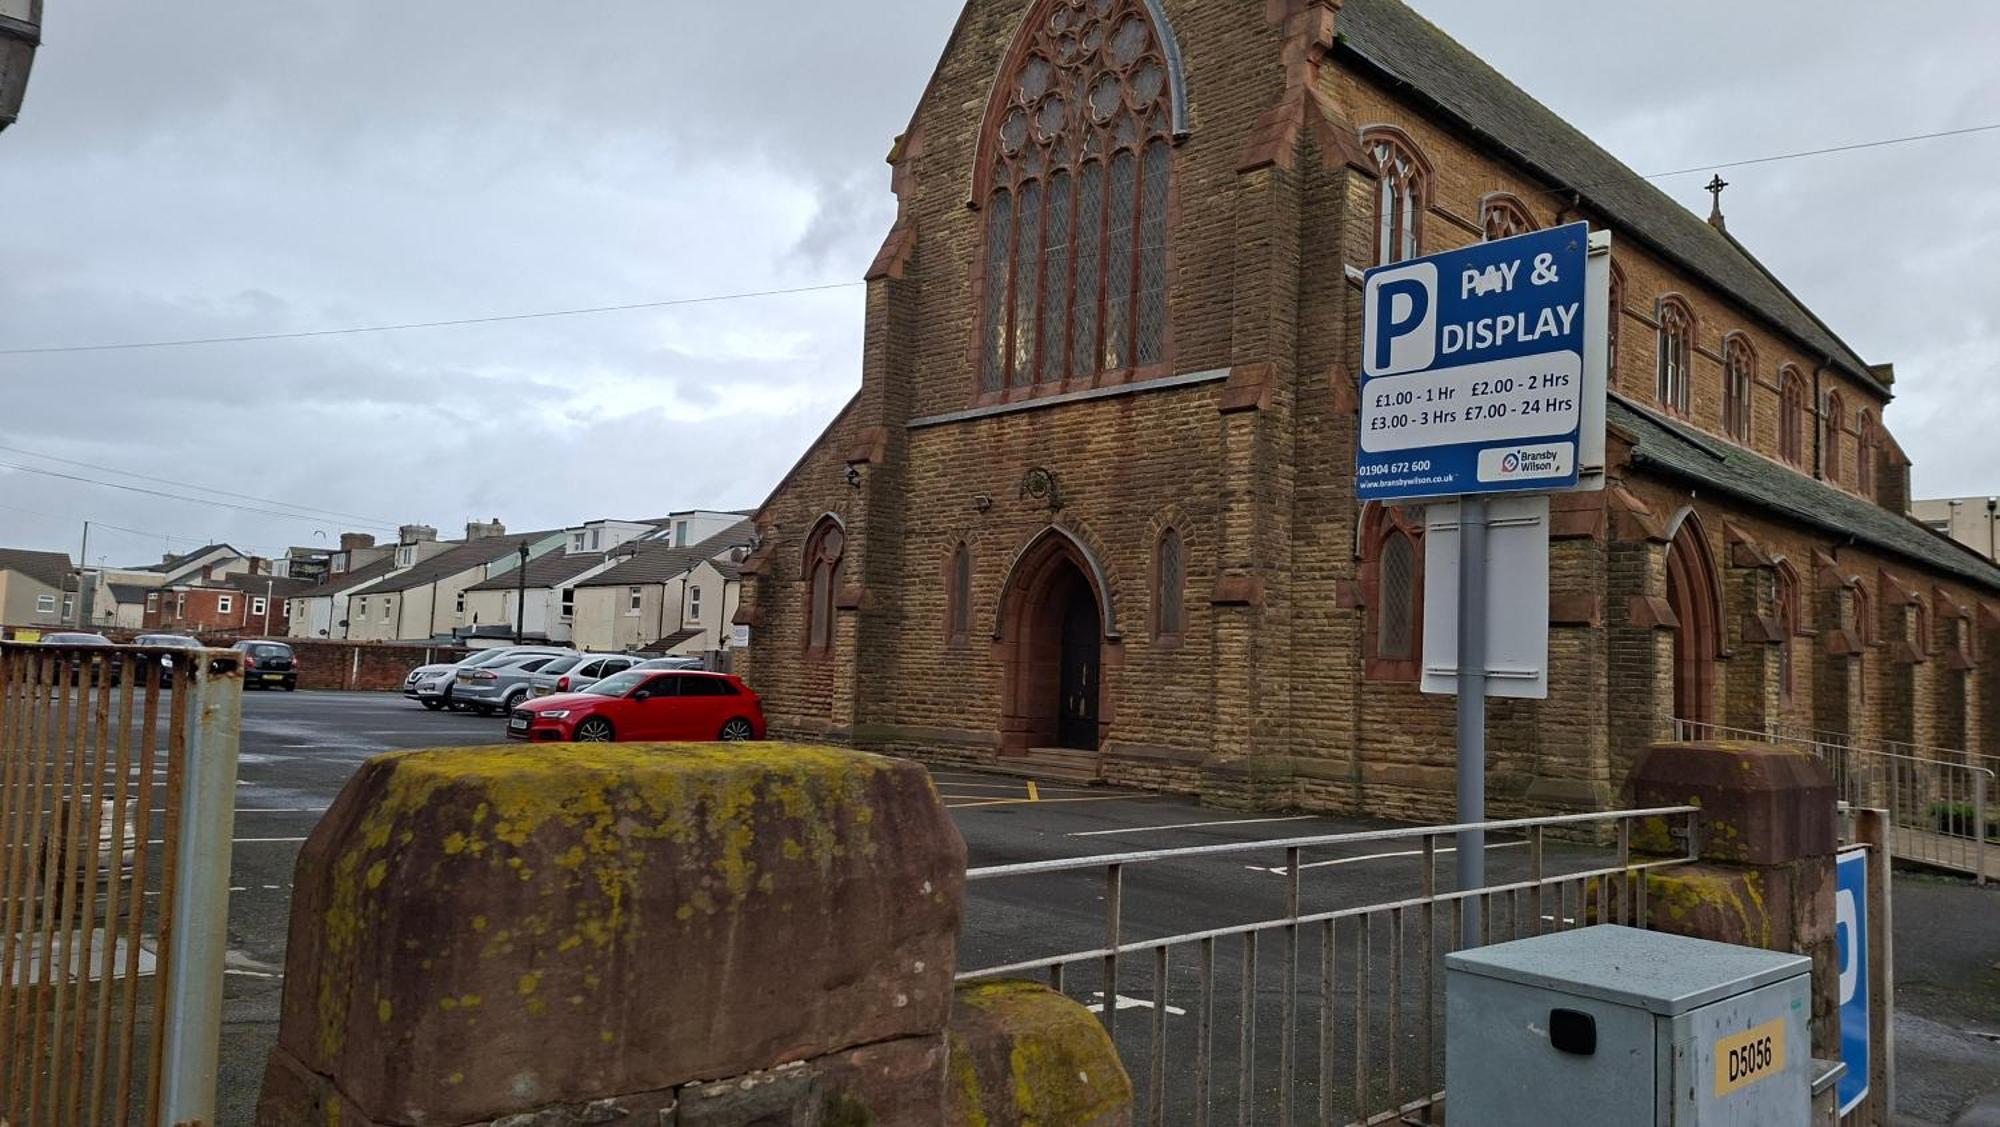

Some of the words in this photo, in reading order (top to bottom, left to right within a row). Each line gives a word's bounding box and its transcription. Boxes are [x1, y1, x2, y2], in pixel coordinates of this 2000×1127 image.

[1462, 259, 1520, 299] PAY
[1531, 253, 1558, 285] &
[1375, 278, 1429, 370] P
[1442, 302, 1579, 354] DISPLAY
[1375, 391, 1413, 408] £1.00
[1426, 388, 1433, 402] 1
[1438, 386, 1456, 401] Hr
[1471, 378, 1514, 397] £2.00
[1528, 375, 1537, 390] 2
[1543, 373, 1569, 388] Hrs
[1371, 414, 1408, 430] £3.00
[1420, 411, 1428, 425] 3
[1433, 410, 1456, 424] Hrs
[1464, 403, 1507, 421] £7.00
[1521, 399, 1540, 415] 24
[1546, 397, 1573, 413] Hrs
[1521, 450, 1557, 461] Bransby
[1521, 462, 1551, 472] Wilson
[1359, 464, 1388, 476] 01904
[1391, 462, 1409, 474] 672
[1411, 460, 1430, 472] 600
[1729, 1035, 1772, 1083] D5056
